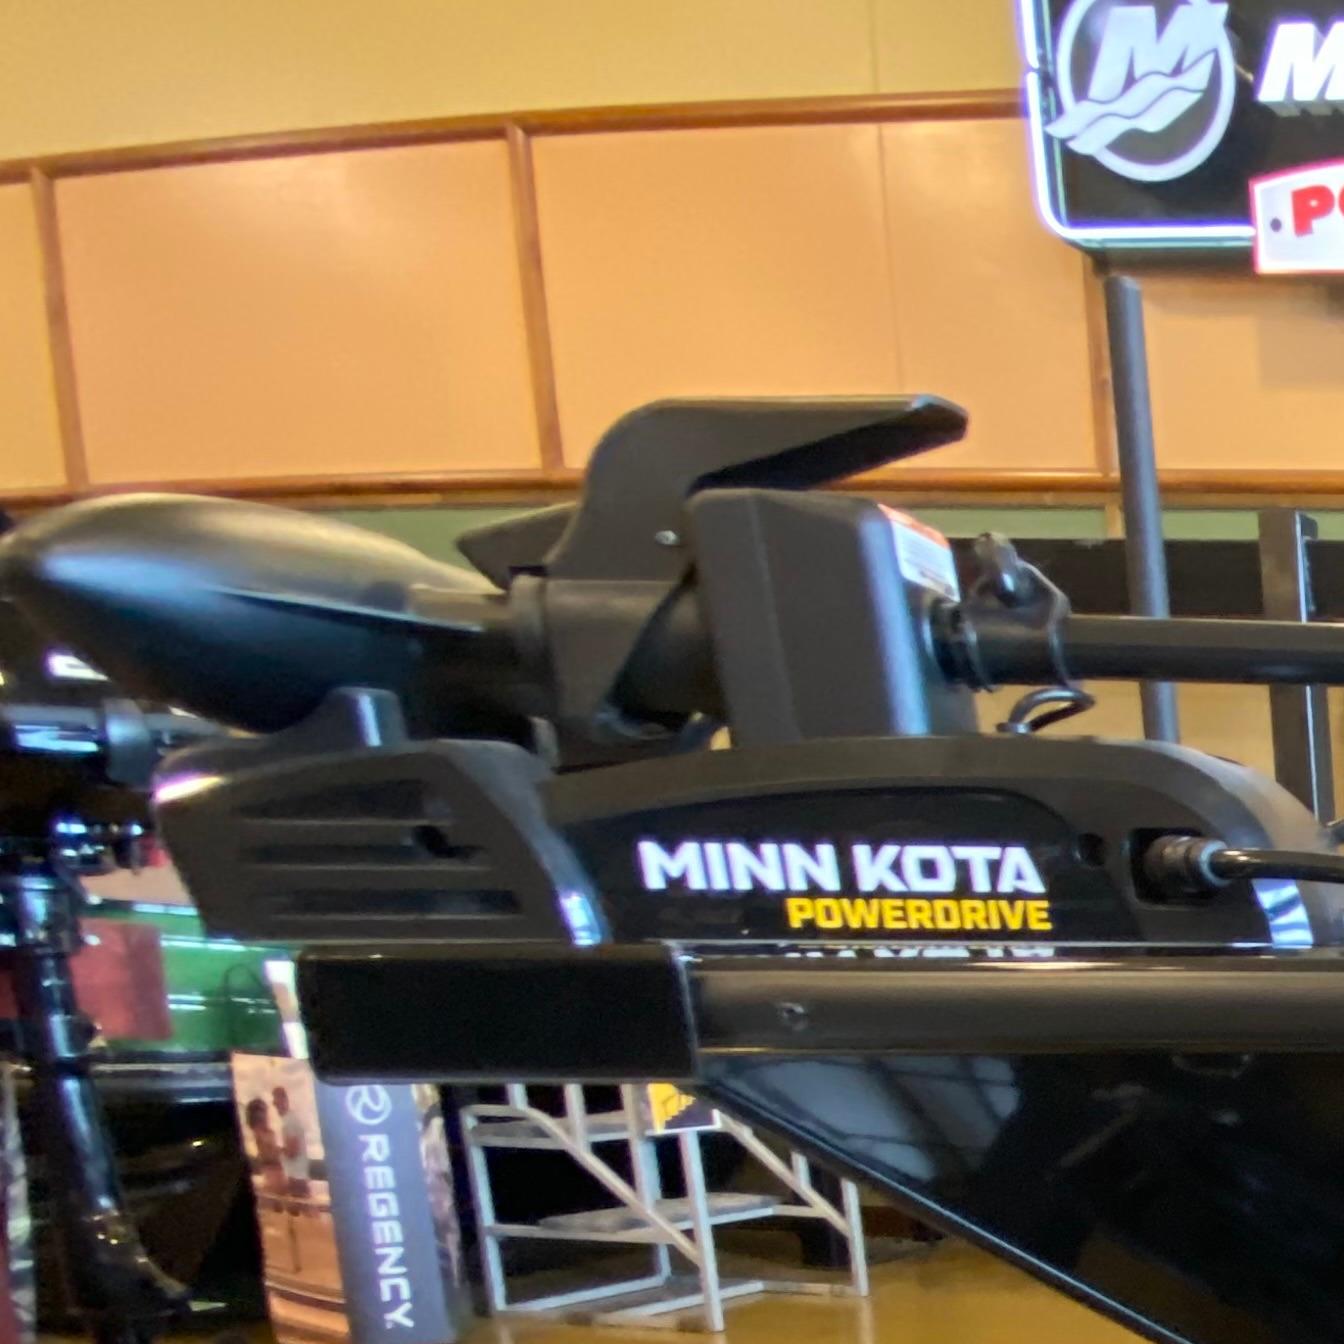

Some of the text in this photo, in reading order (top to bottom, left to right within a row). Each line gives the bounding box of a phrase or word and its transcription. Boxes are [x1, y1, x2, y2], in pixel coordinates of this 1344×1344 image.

[636, 838, 1047, 894] MINN KOTA
[786, 896, 1053, 932] POWERDRIVE
[358, 1133, 414, 1329] REGENCY
